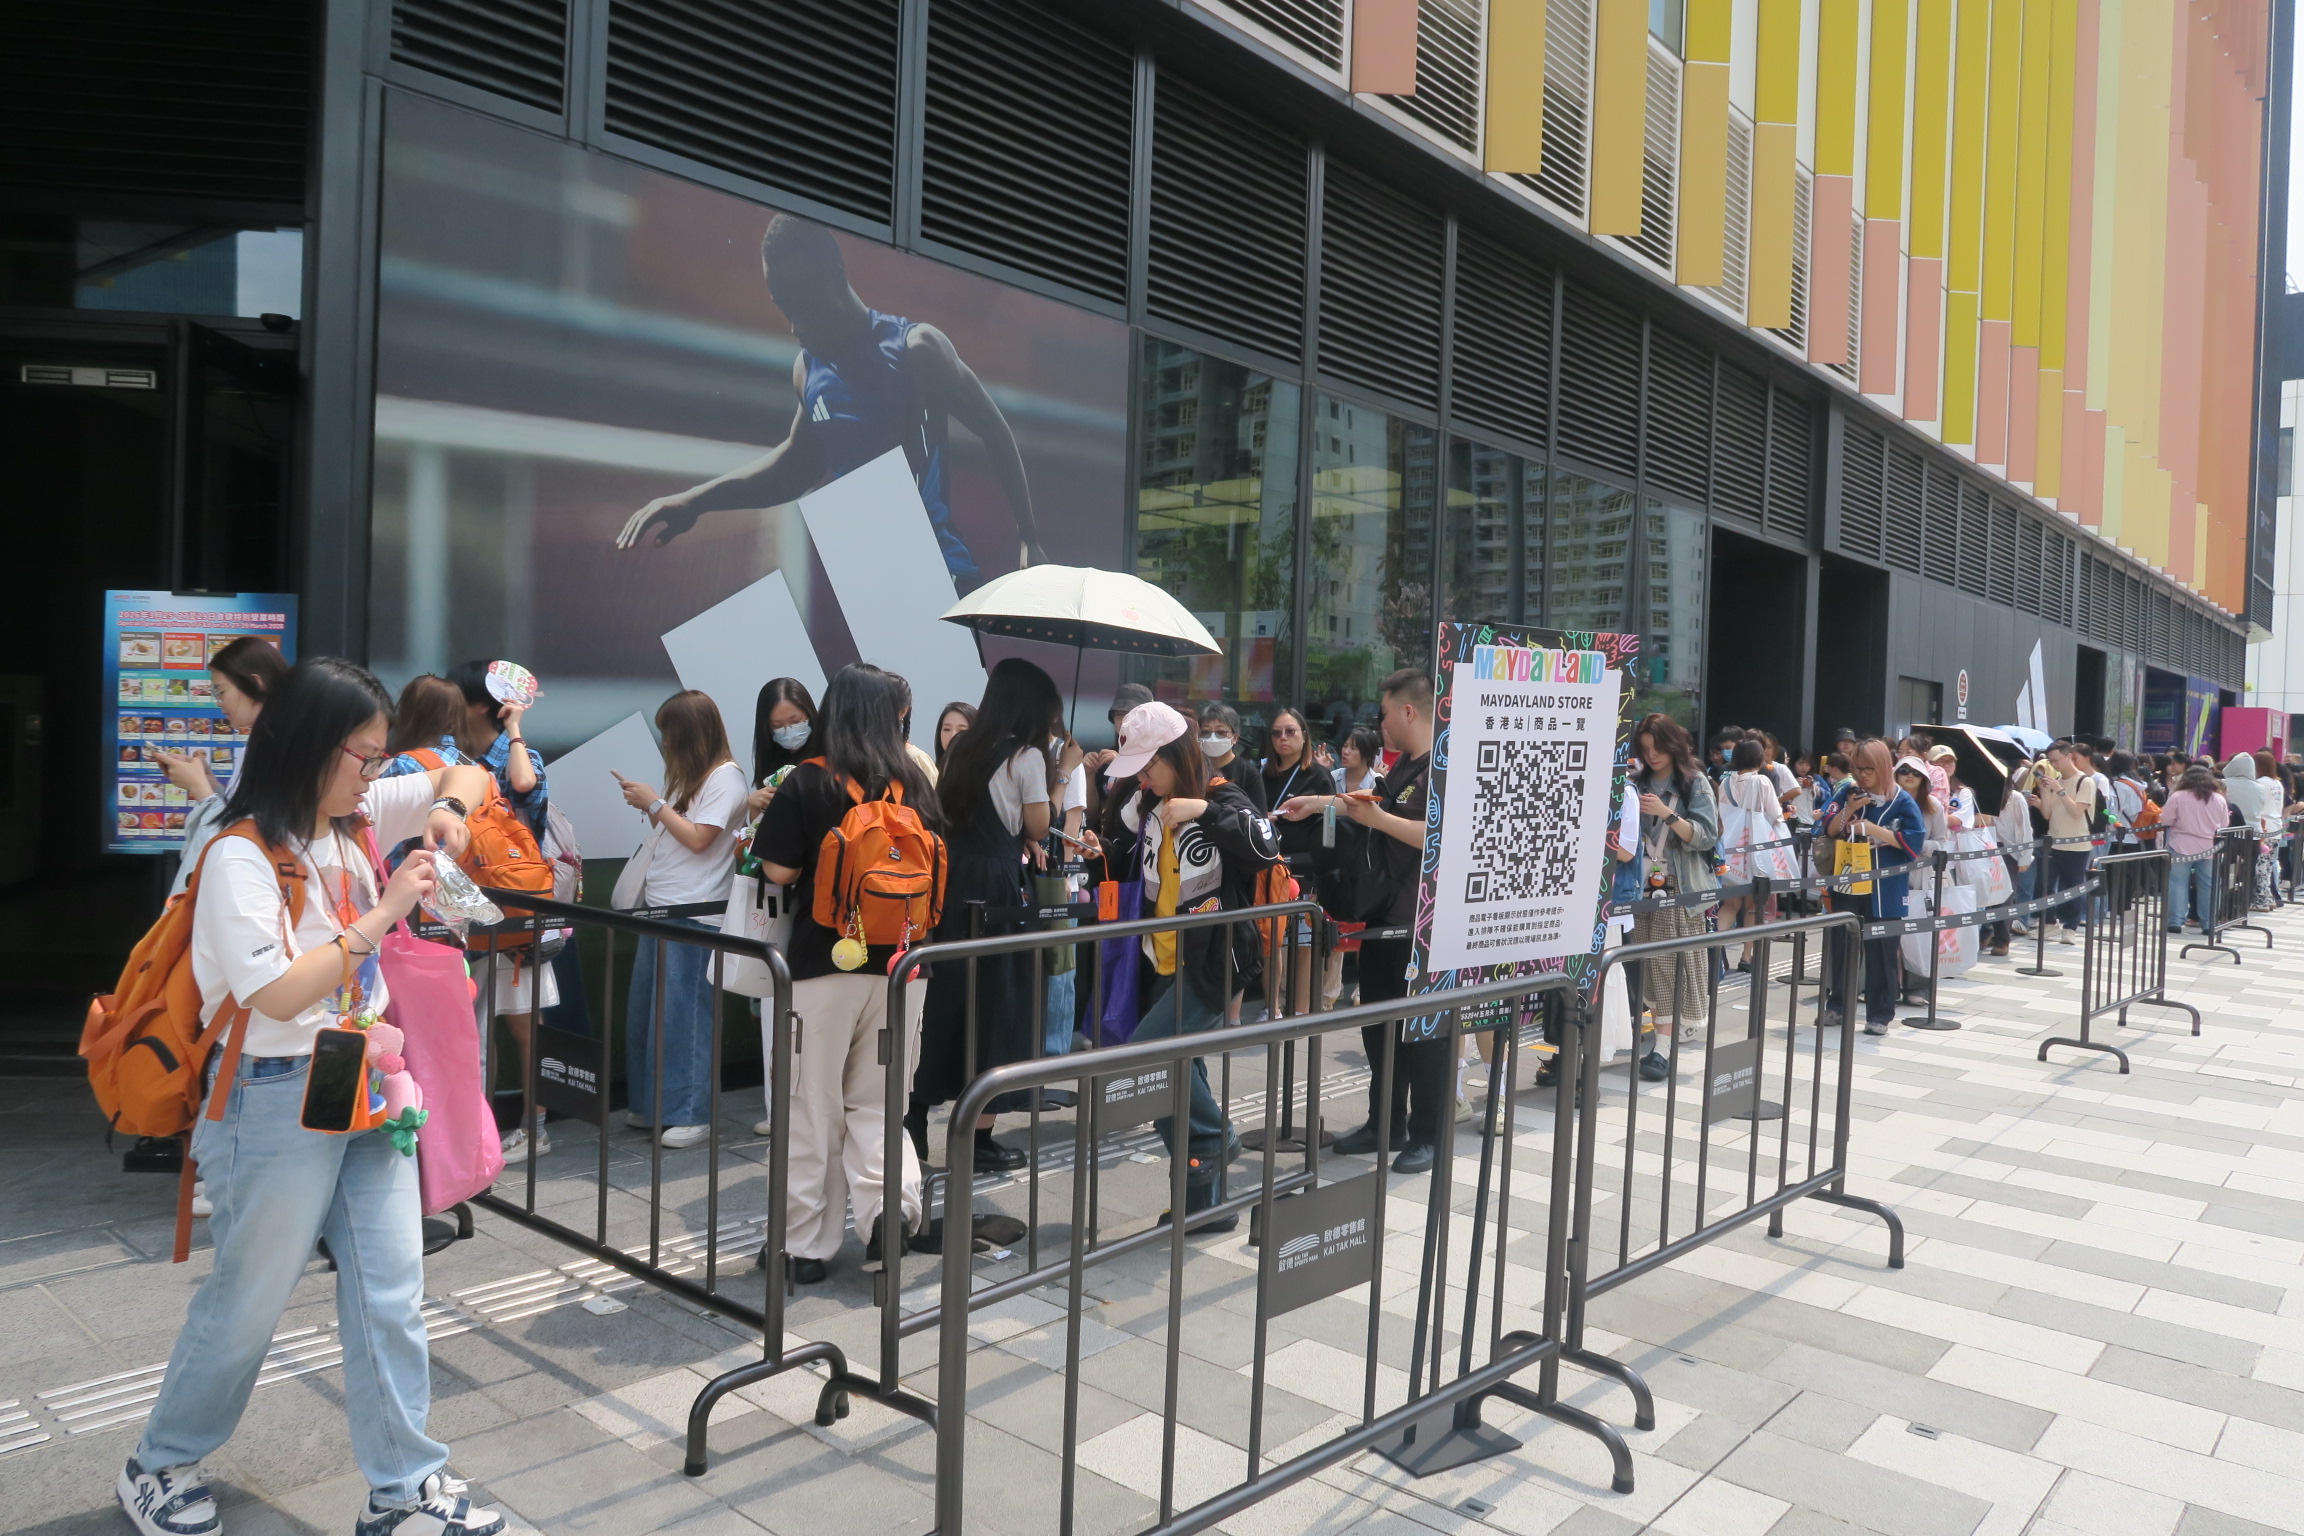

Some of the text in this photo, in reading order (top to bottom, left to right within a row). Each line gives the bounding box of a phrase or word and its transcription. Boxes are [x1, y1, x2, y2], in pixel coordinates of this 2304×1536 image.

[1480, 694, 1593, 709] MAYDAYLAND STORE
[1156, 1082, 1168, 1090] MALL
[1323, 1234, 1367, 1257] KAI TAK MALL
[1309, 1254, 1319, 1262] PARK
